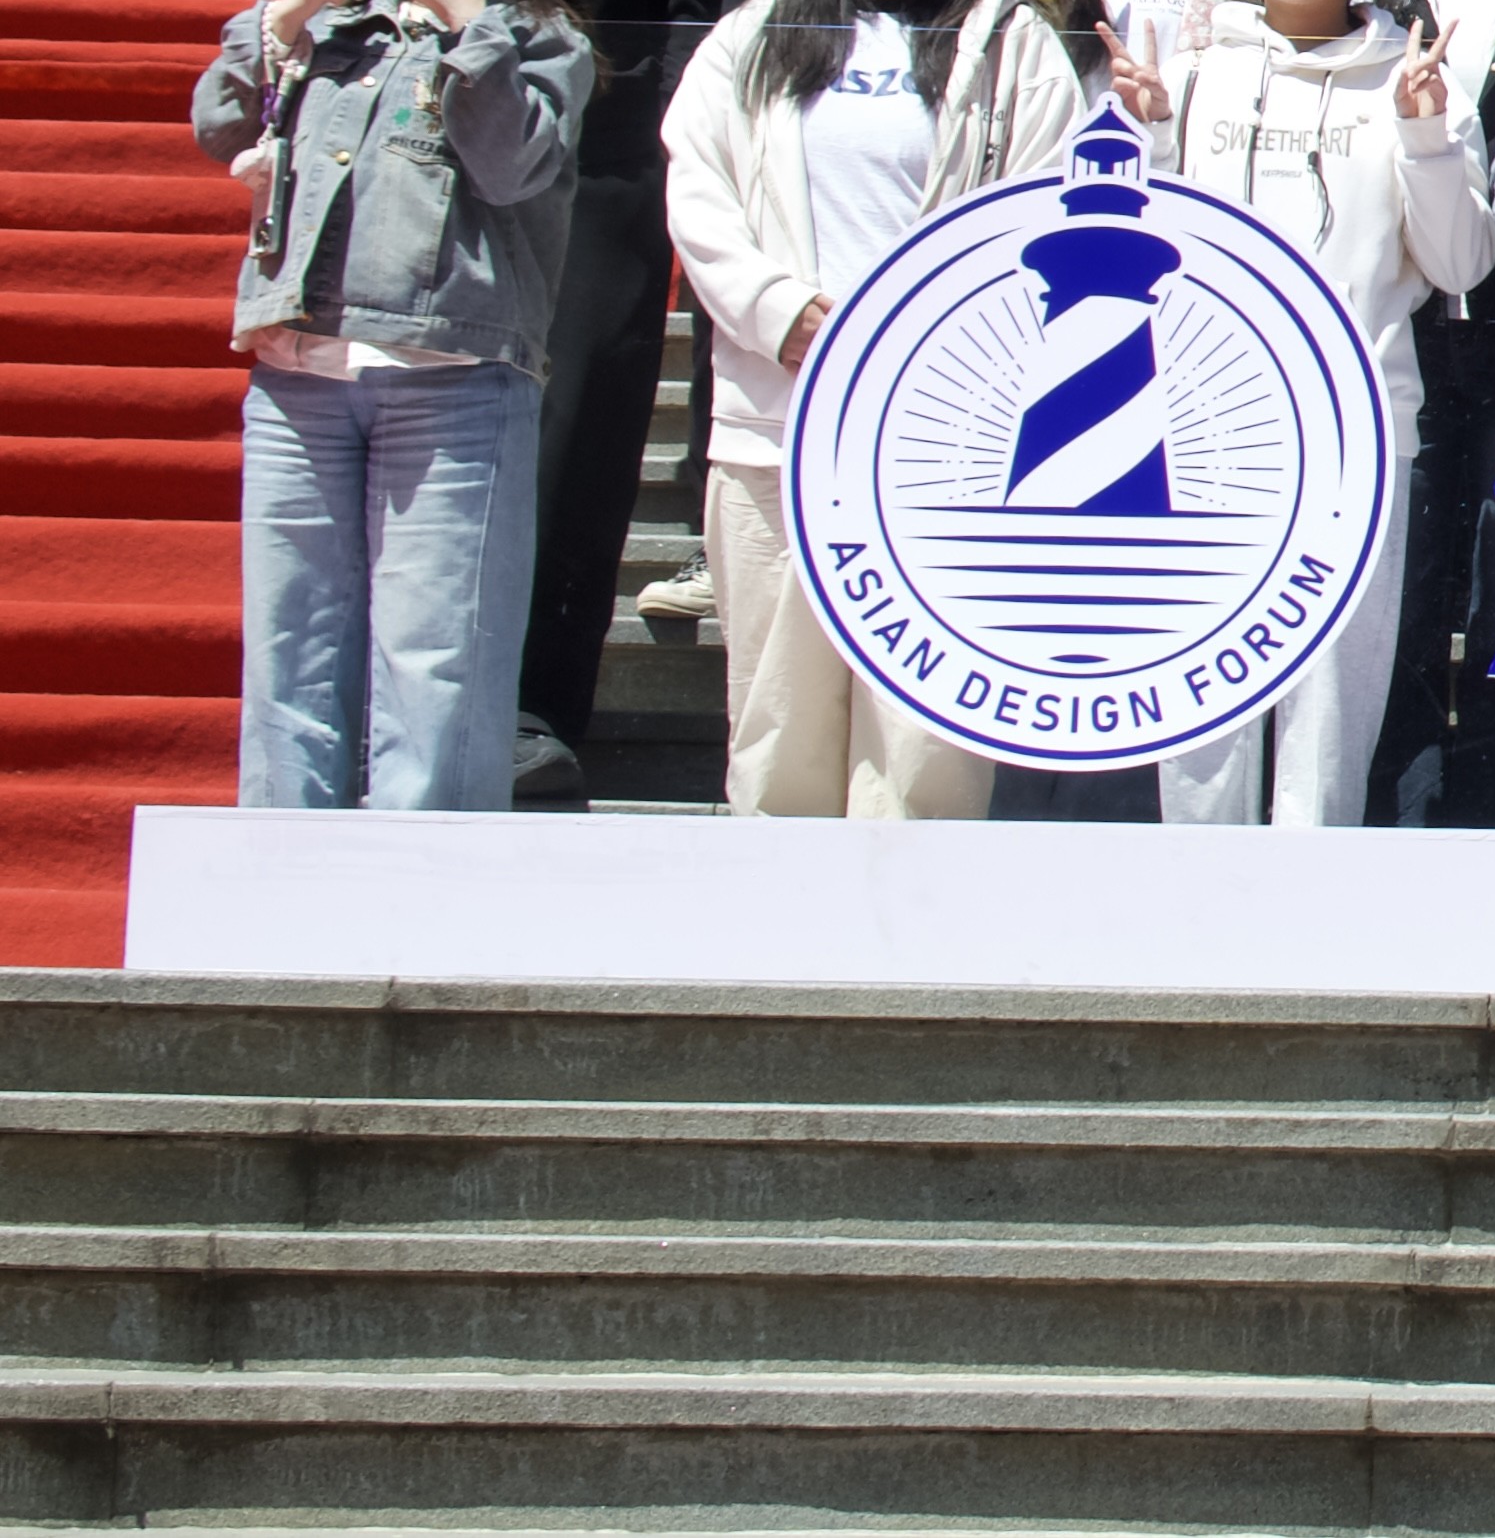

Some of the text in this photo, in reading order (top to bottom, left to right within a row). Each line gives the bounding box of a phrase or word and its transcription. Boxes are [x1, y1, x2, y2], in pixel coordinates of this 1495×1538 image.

[1211, 120, 1357, 158] SWEETHEART
[827, 542, 1335, 734] ASIAN DESIGN FORUM
